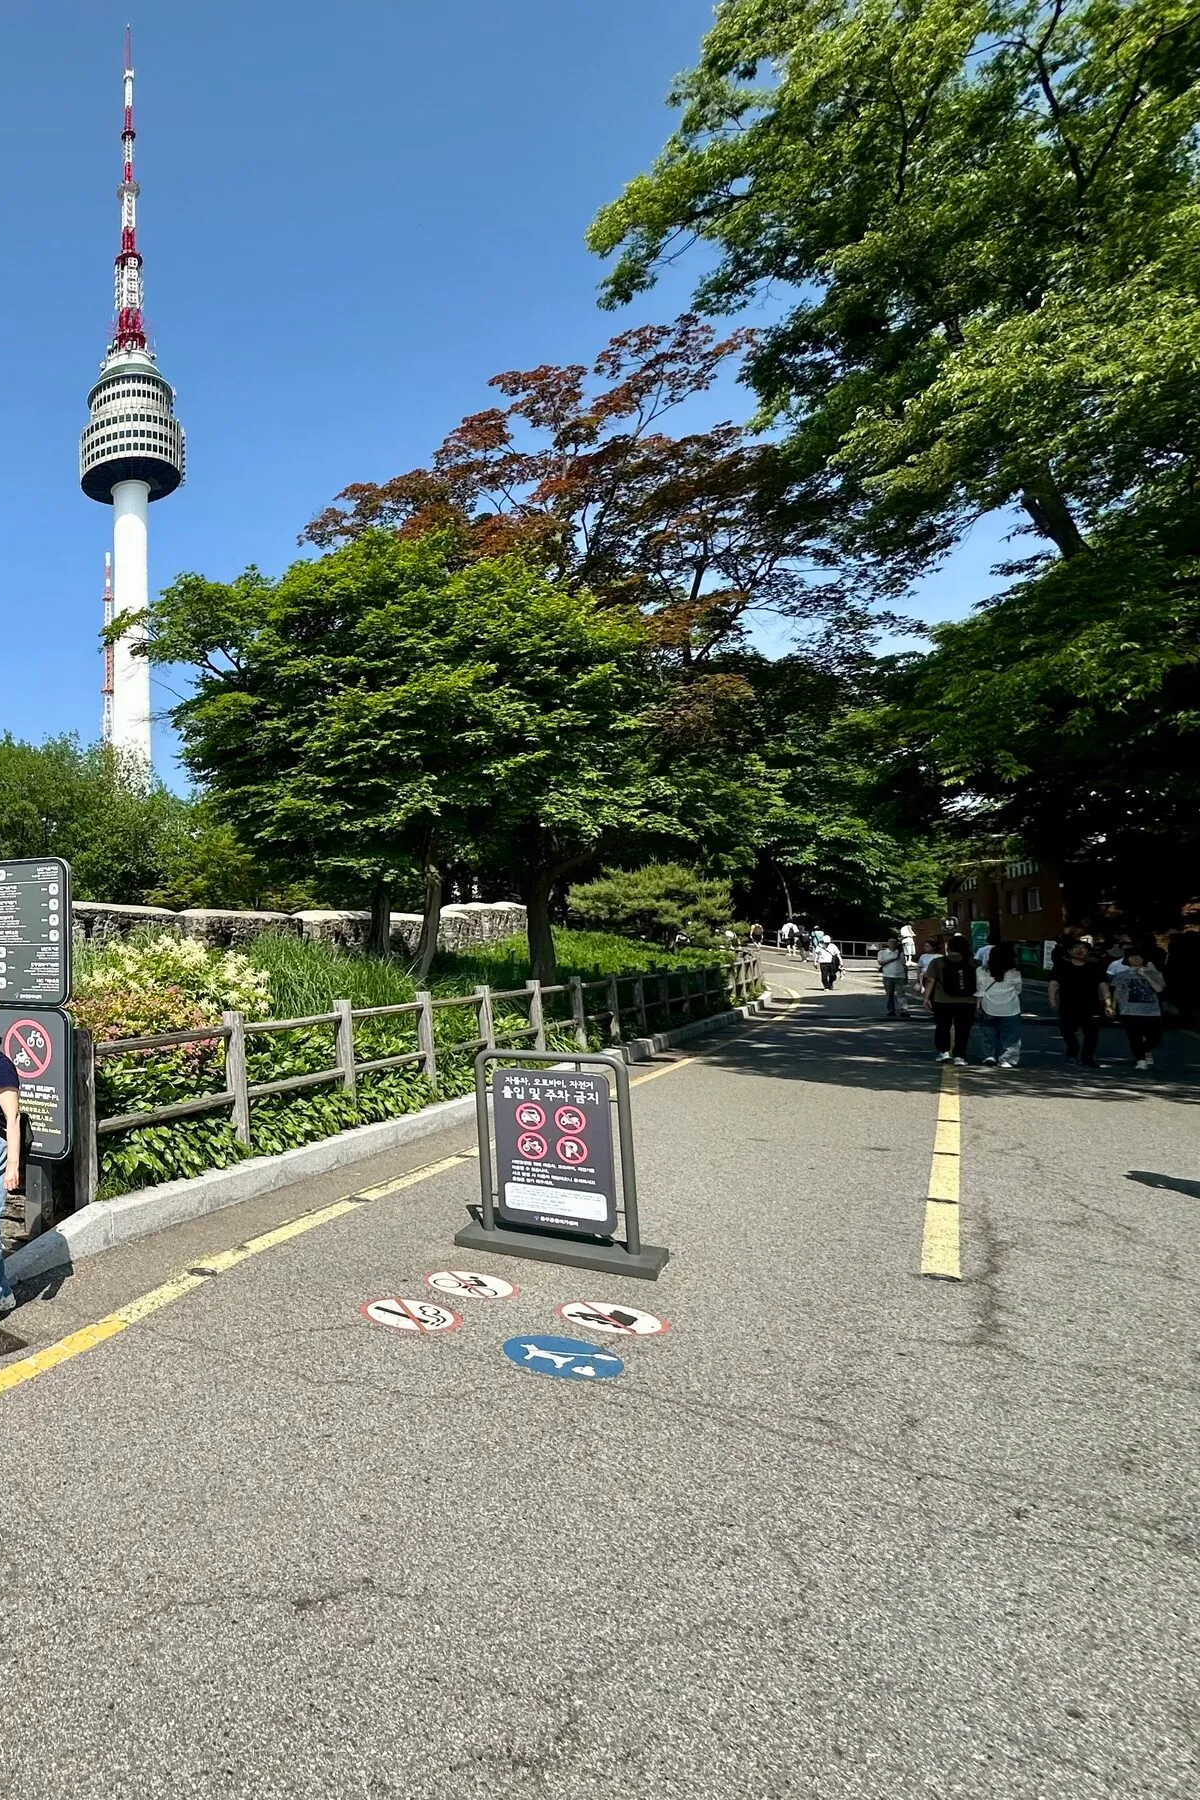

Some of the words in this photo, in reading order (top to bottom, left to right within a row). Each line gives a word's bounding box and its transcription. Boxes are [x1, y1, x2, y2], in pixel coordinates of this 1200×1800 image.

[569, 1080, 594, 1090] 자전거
[501, 1085, 525, 1100] 출입
[528, 1087, 541, 1101] 및
[544, 1088, 571, 1103] 주차
[573, 1091, 599, 1105] 금지
[565, 1141, 578, 1158] P
